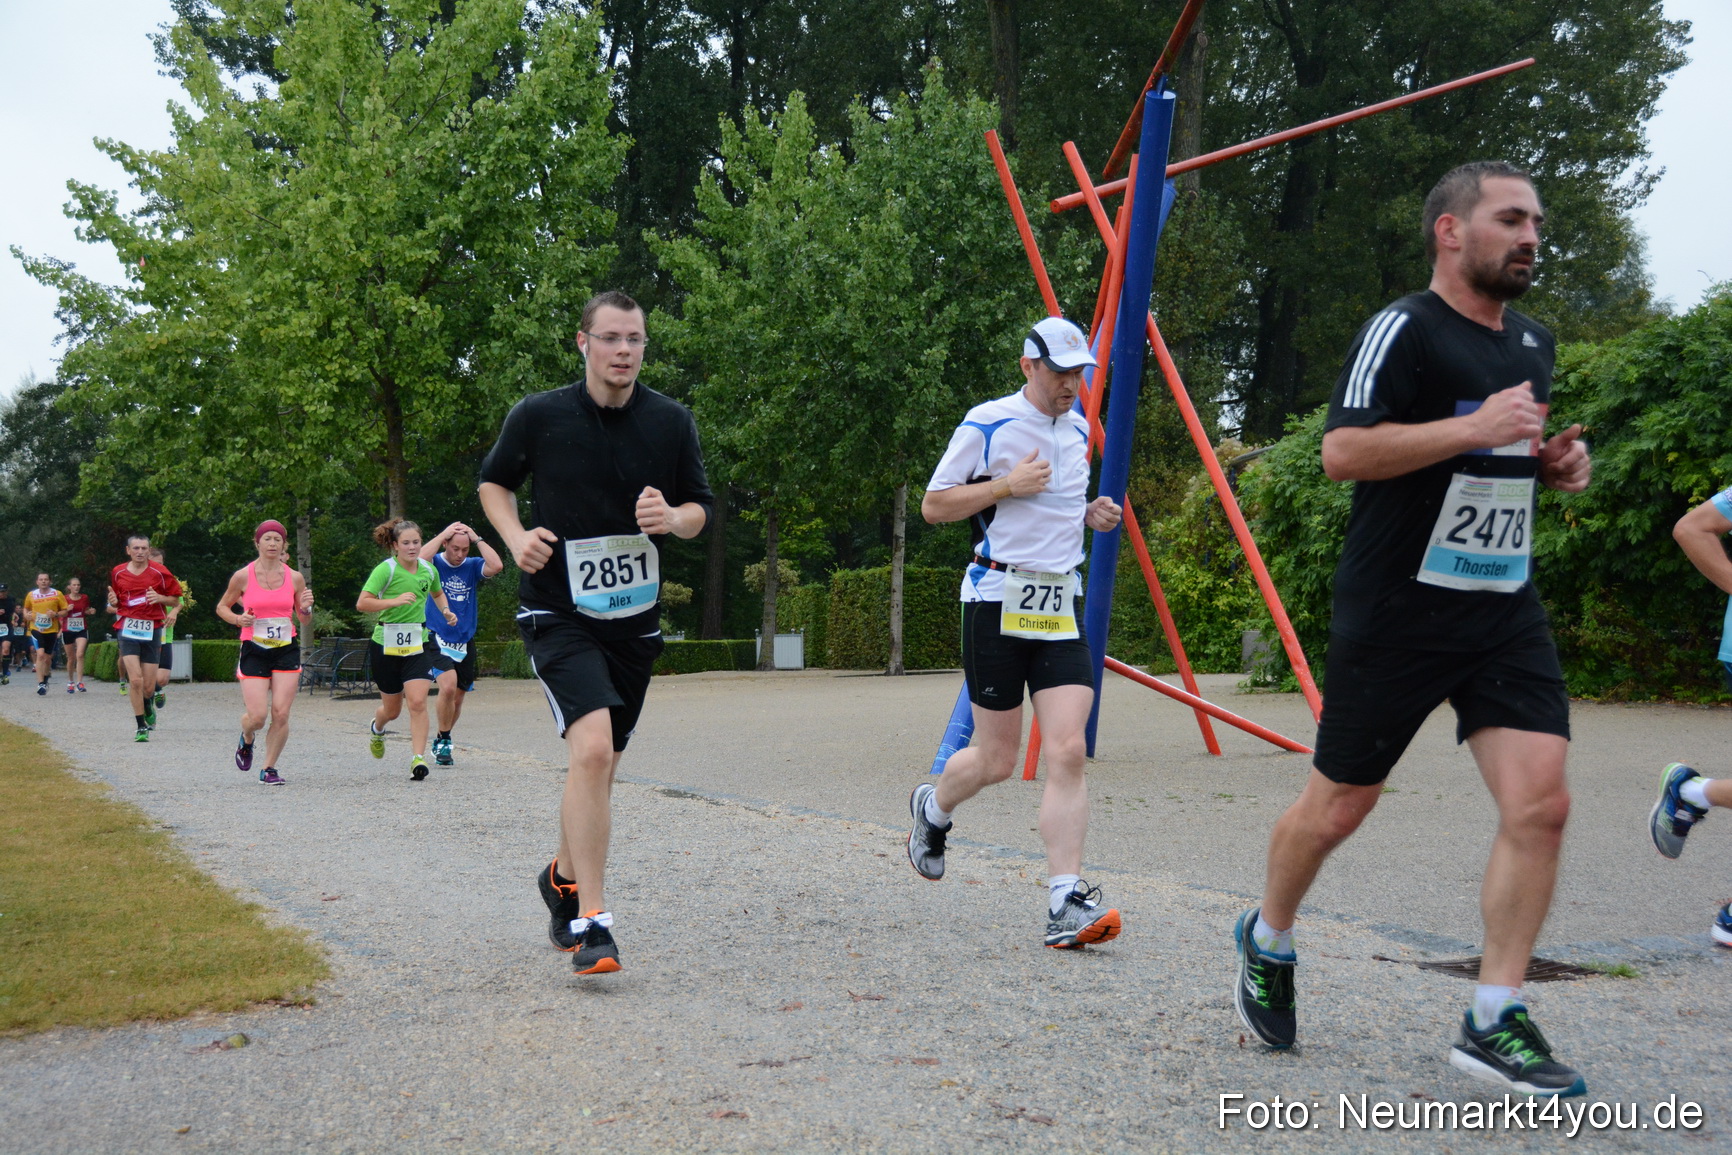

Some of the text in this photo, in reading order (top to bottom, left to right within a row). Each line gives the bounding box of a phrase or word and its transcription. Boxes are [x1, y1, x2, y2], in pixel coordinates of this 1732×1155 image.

[1445, 505, 1526, 549] 2478
[575, 547, 604, 555] NeuerMarkt
[579, 552, 649, 591] 2851
[1453, 556, 1508, 577] Thorsten
[609, 595, 632, 609] Alex
[1019, 584, 1064, 612] 275
[127, 618, 152, 631] 2413
[1019, 617, 1060, 631] Christian
[266, 626, 281, 639] 51
[396, 632, 412, 646] 84
